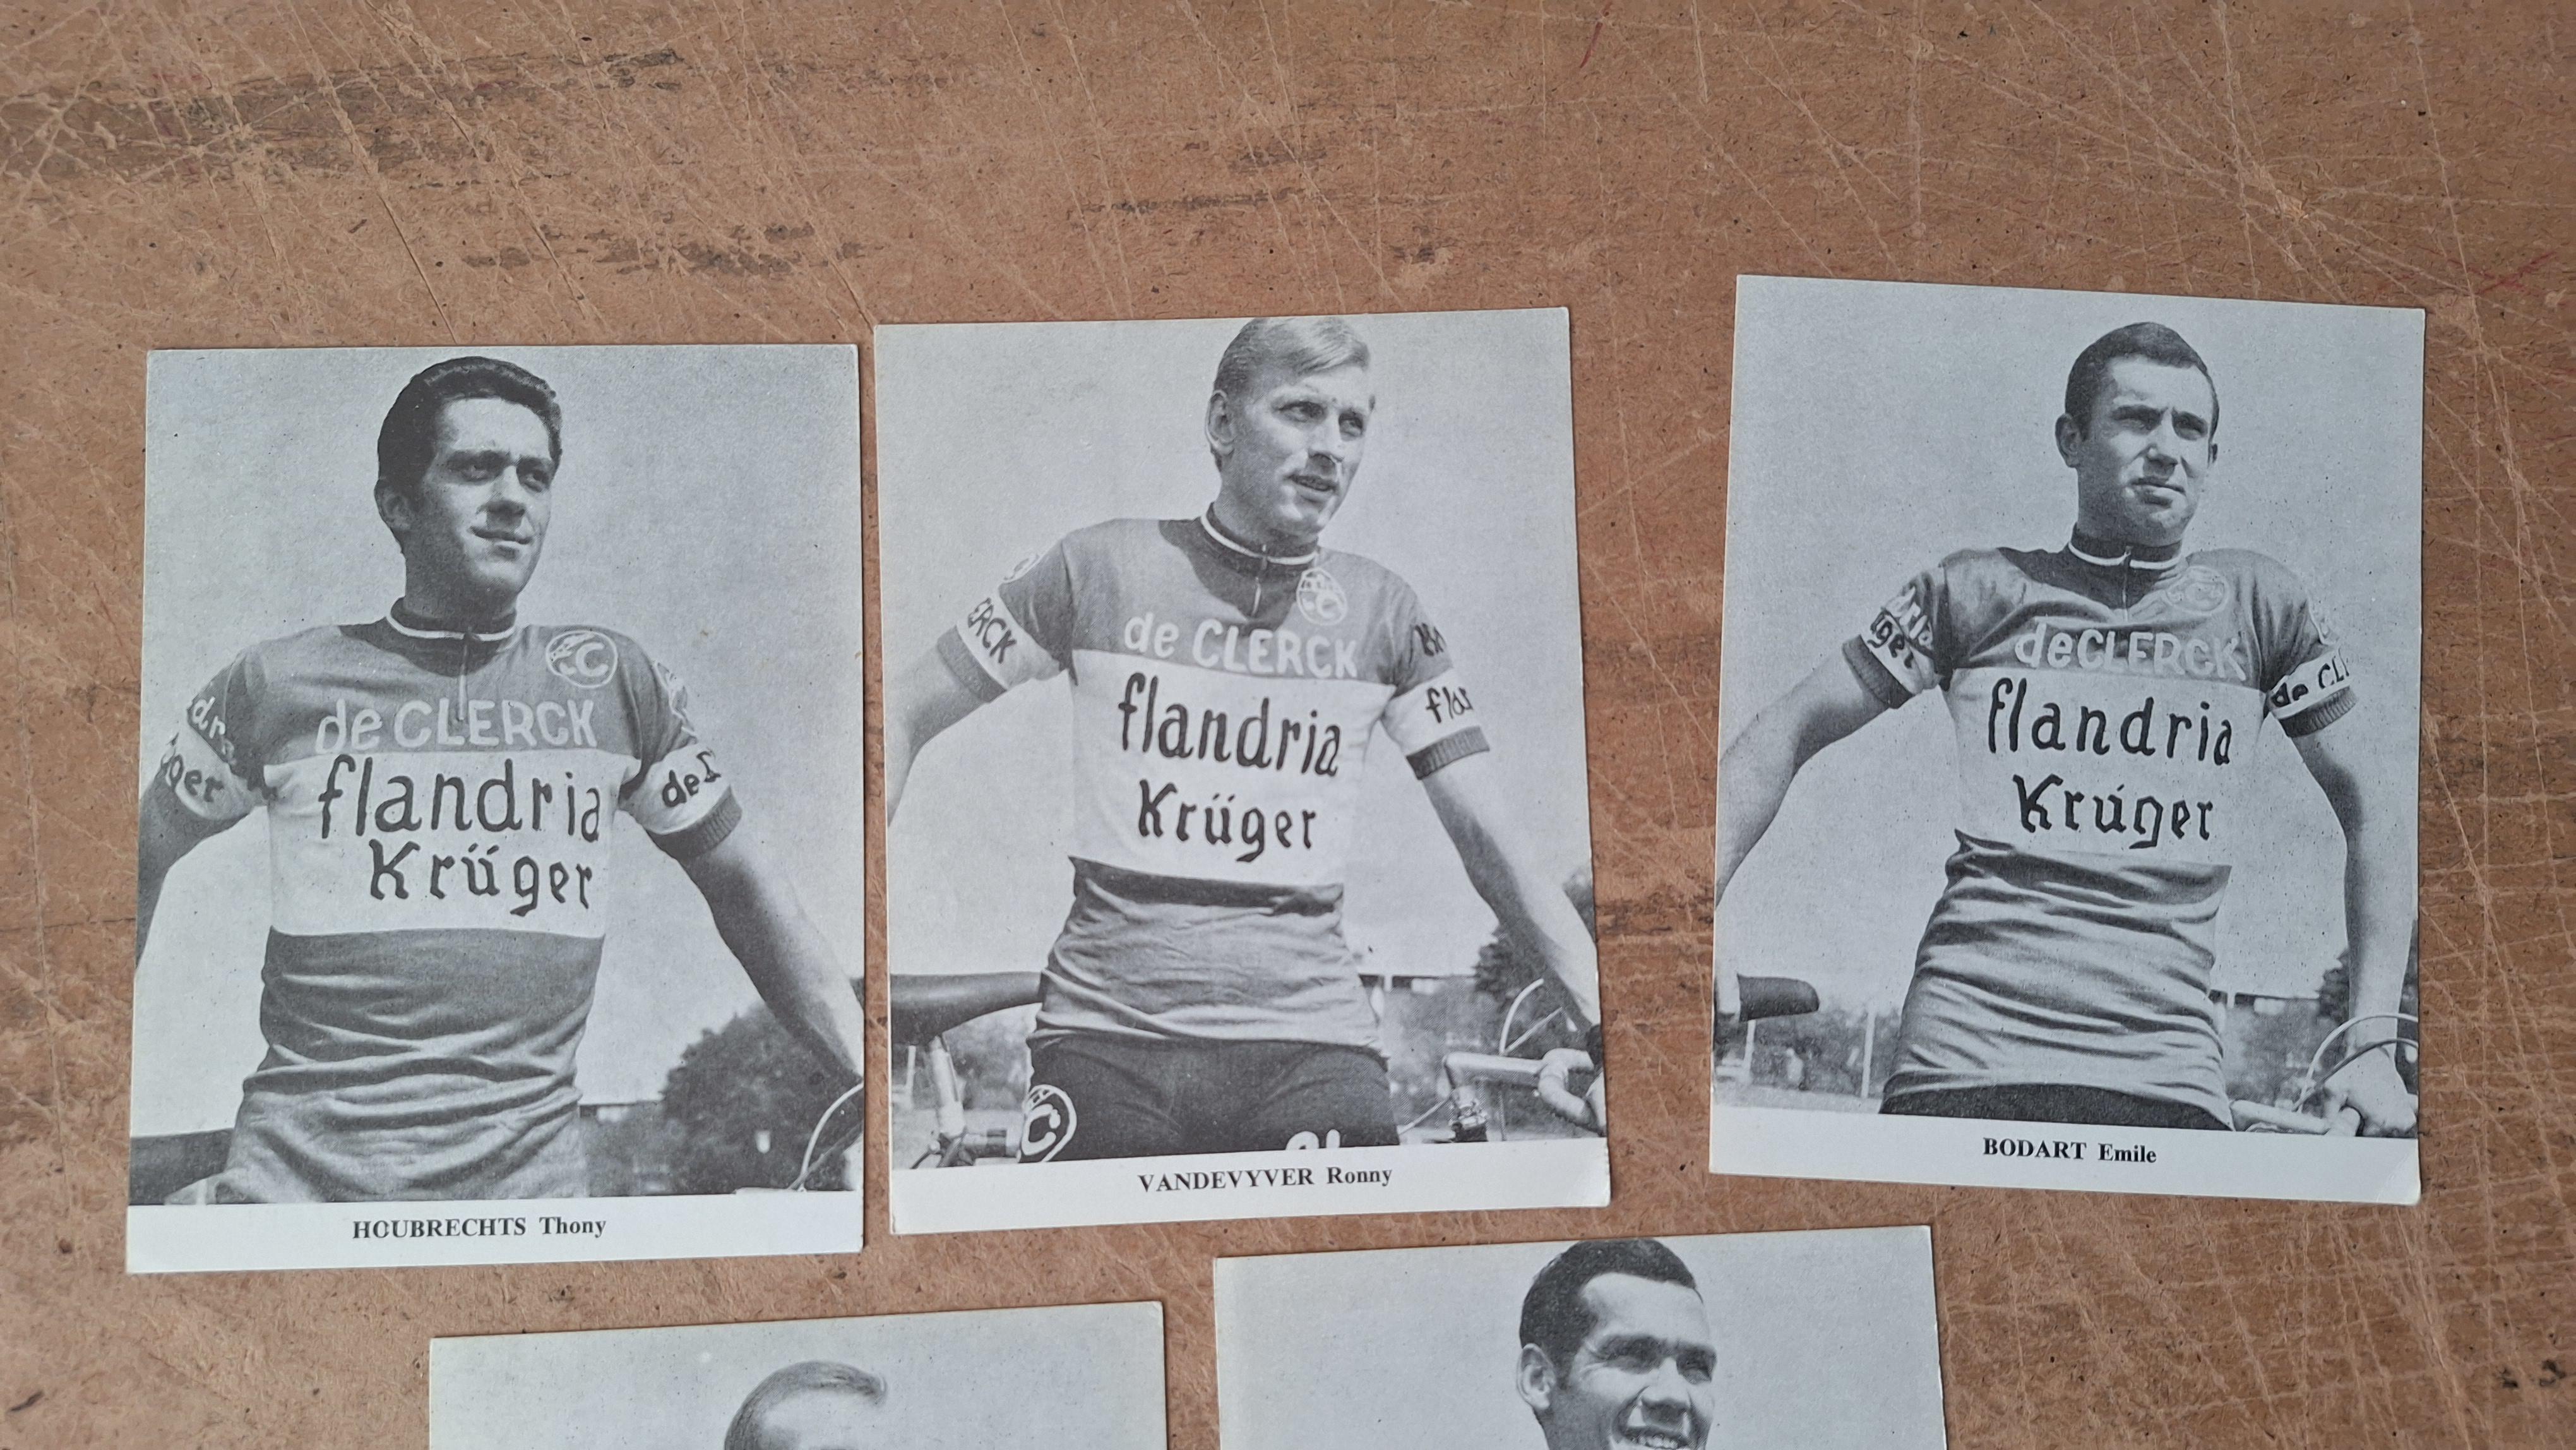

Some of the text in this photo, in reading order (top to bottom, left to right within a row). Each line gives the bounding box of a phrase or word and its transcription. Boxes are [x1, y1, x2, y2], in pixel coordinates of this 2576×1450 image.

[1192, 619, 1358, 679] CLERCK
[394, 698, 597, 750] CLERCK
[1118, 672, 1343, 777] flandria
[1988, 677, 2233, 765] flandria
[318, 754, 601, 842] flandria
[1983, 1137, 2157, 1163] BODART Emile
[1137, 1166, 1393, 1192] VANDEVYVER Ronny
[352, 1216, 606, 1239] HOUBRECHTS Thony
